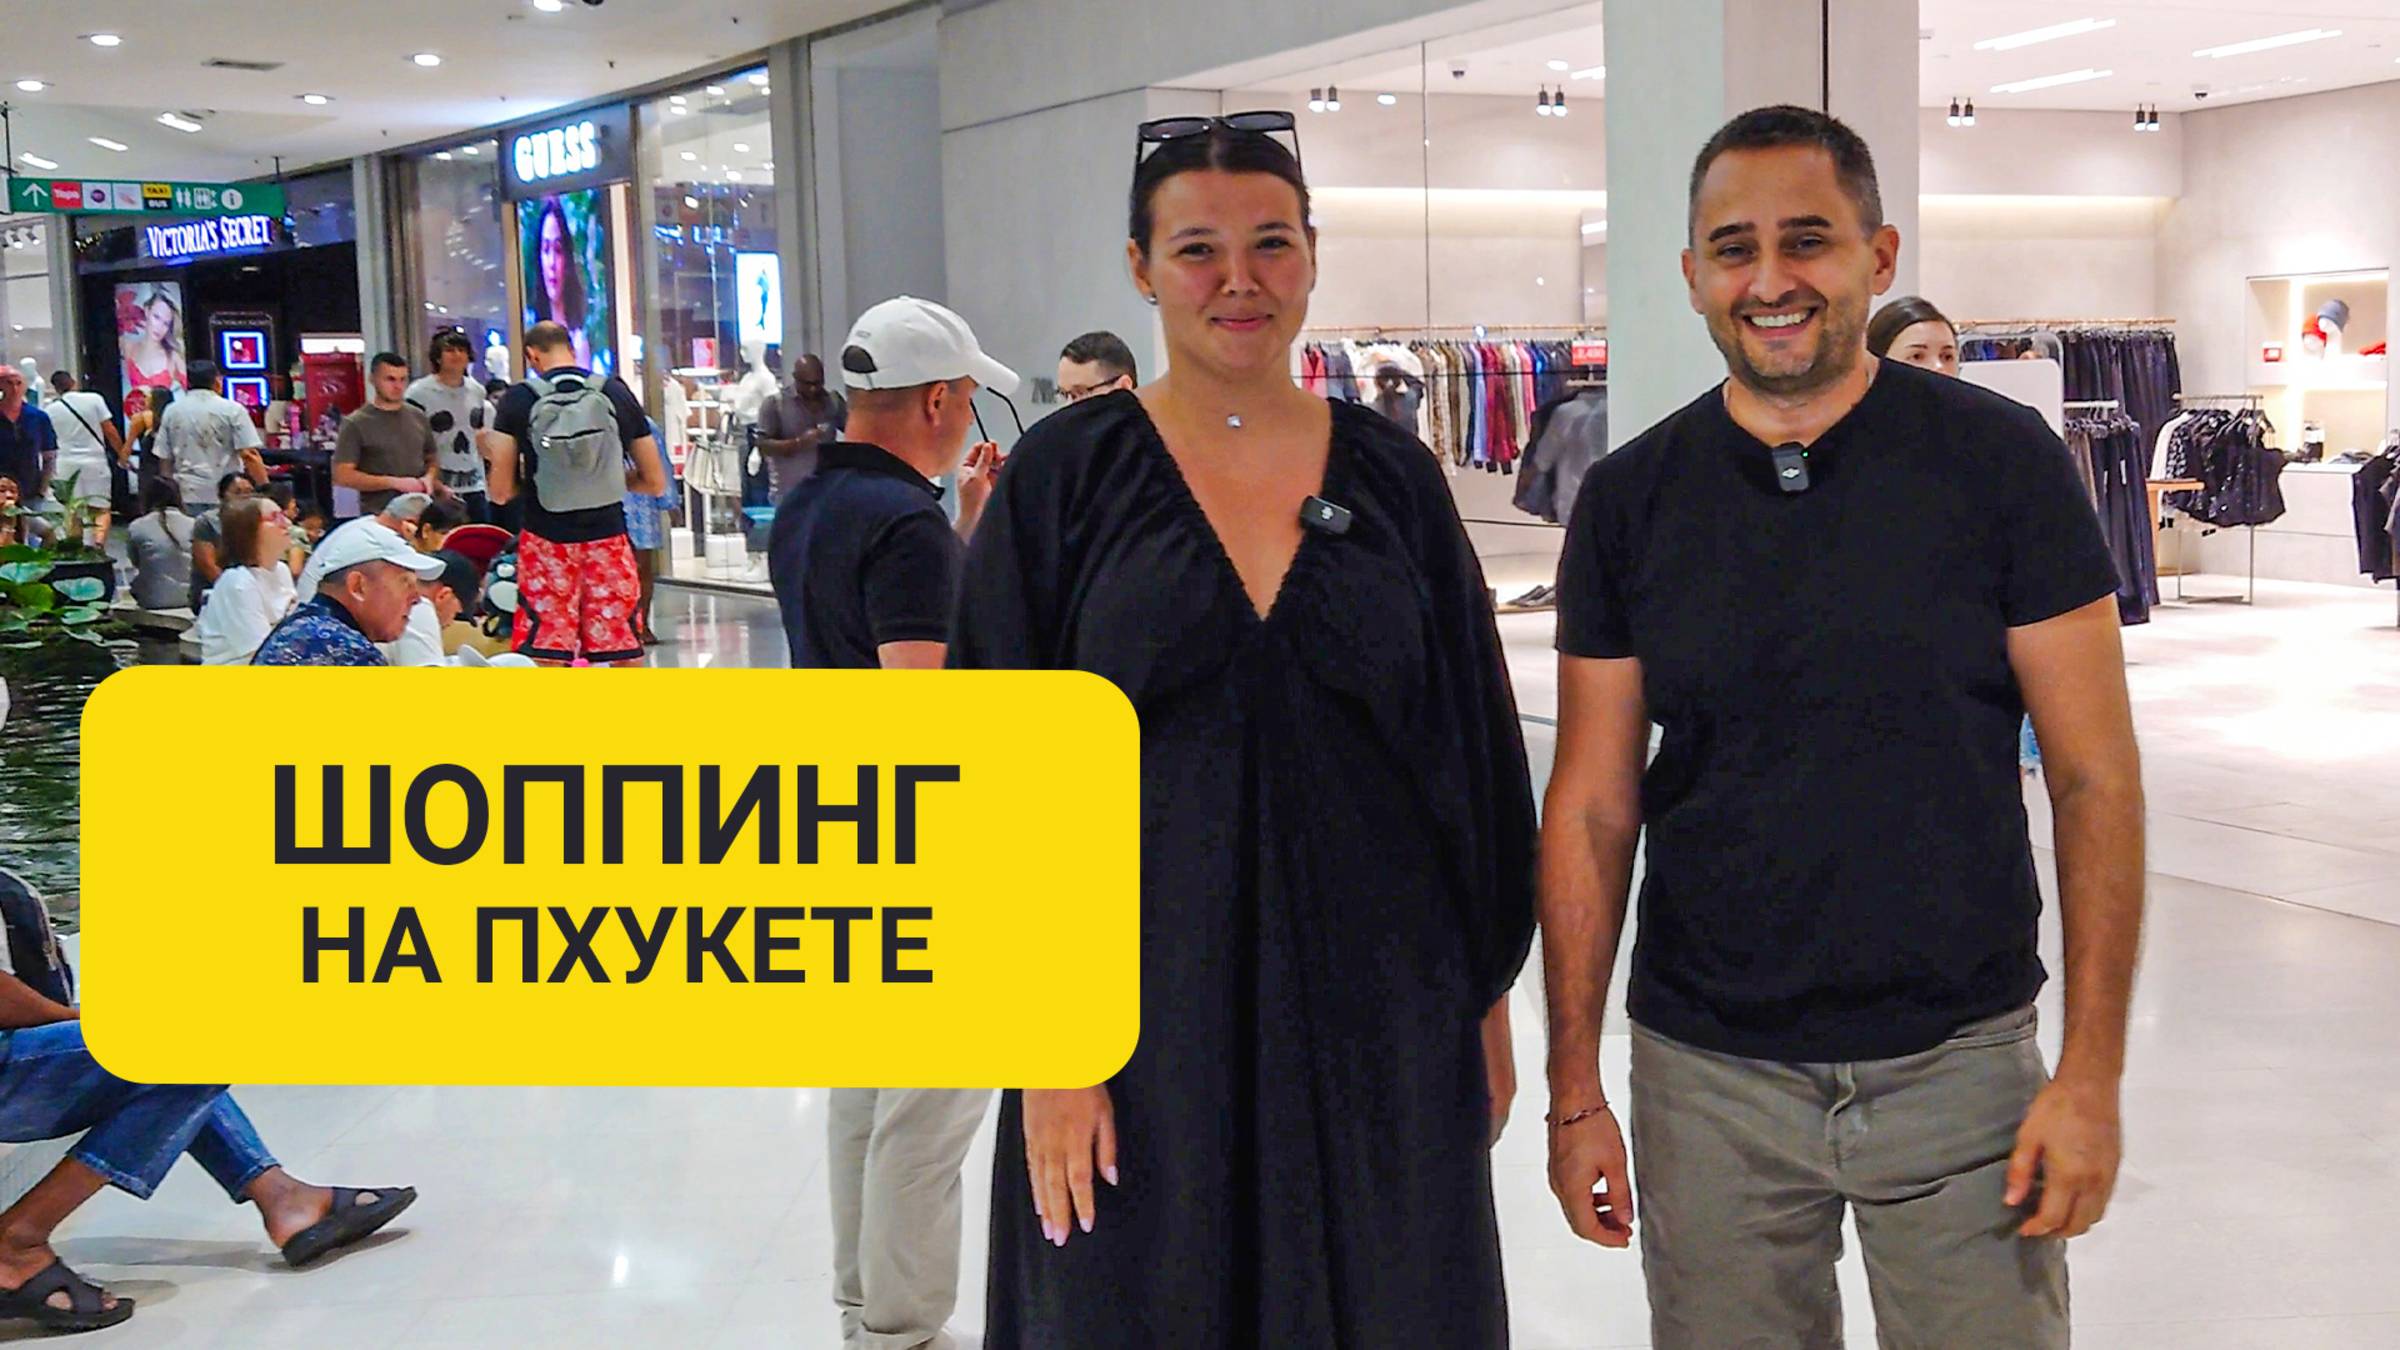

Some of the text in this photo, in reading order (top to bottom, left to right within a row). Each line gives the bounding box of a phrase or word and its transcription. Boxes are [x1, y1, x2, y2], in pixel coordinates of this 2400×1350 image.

[515, 121, 596, 182] GUESS
[146, 186, 169, 194] TAXI
[146, 215, 273, 257] VICTORIA'S SECRET
